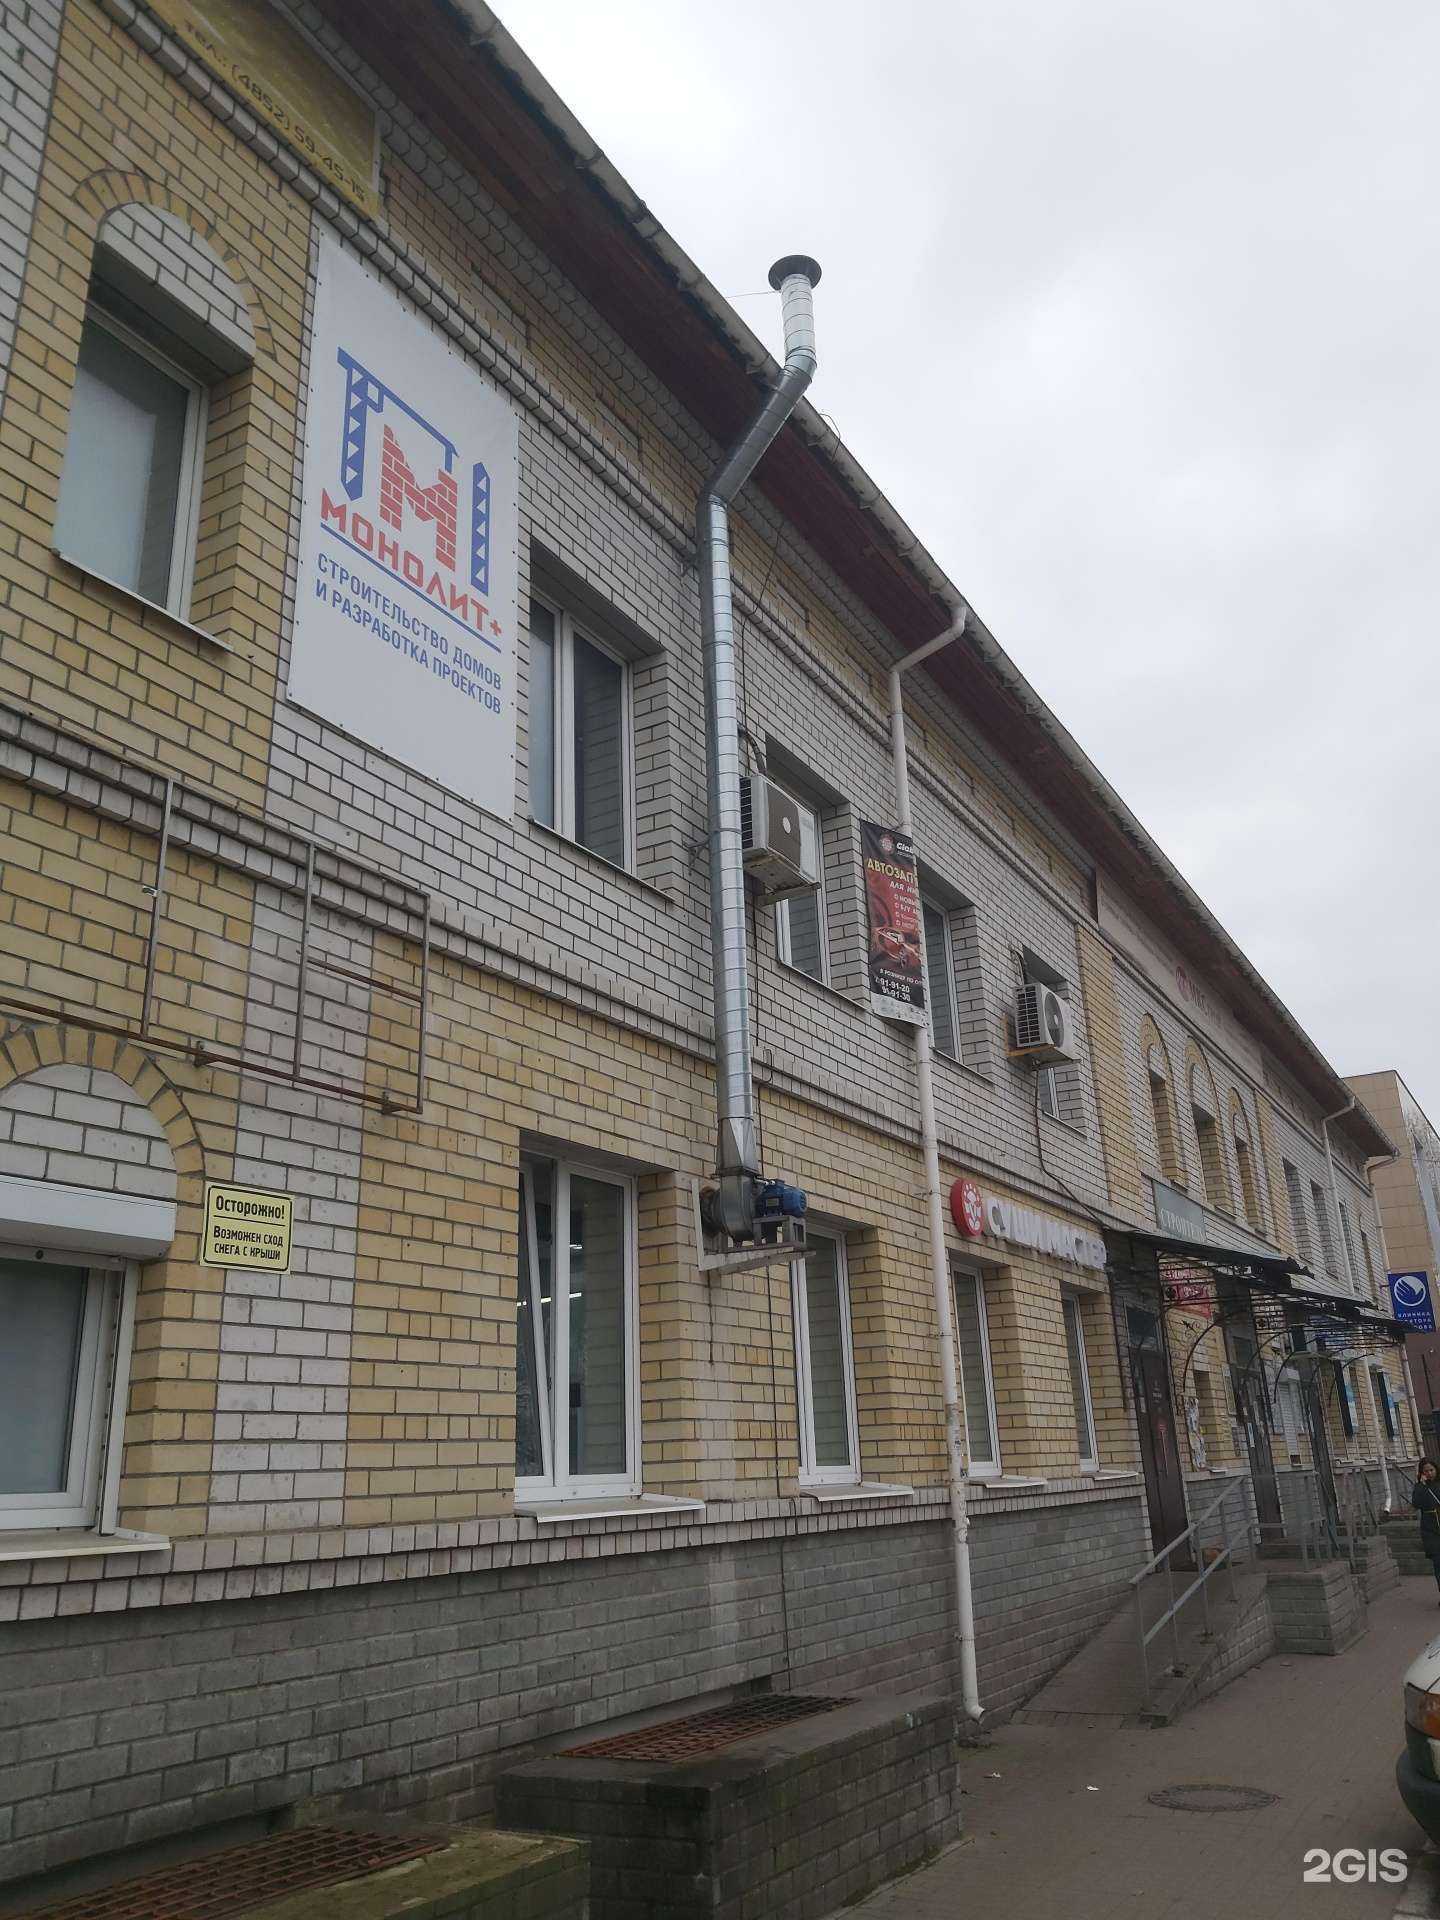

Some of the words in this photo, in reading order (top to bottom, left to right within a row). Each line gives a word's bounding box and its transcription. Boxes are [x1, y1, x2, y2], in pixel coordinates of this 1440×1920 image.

[232, 64, 289, 130] (4852)
[317, 552, 448, 656] СТРОИТЕЛЬСТВО
[452, 646, 501, 691] ДОМОВ
[315, 579, 327, 602] И
[332, 589, 428, 669] РАЗРАБОТКА
[433, 656, 501, 715] ПРОЕКТОВ
[215, 1195, 285, 1220] Осторожно!
[214, 1242, 240, 1256] СНЕГА
[242, 1246, 248, 1256] С
[250, 1247, 281, 1260] КРЫШИ
[263, 1234, 284, 1248] СХОД
